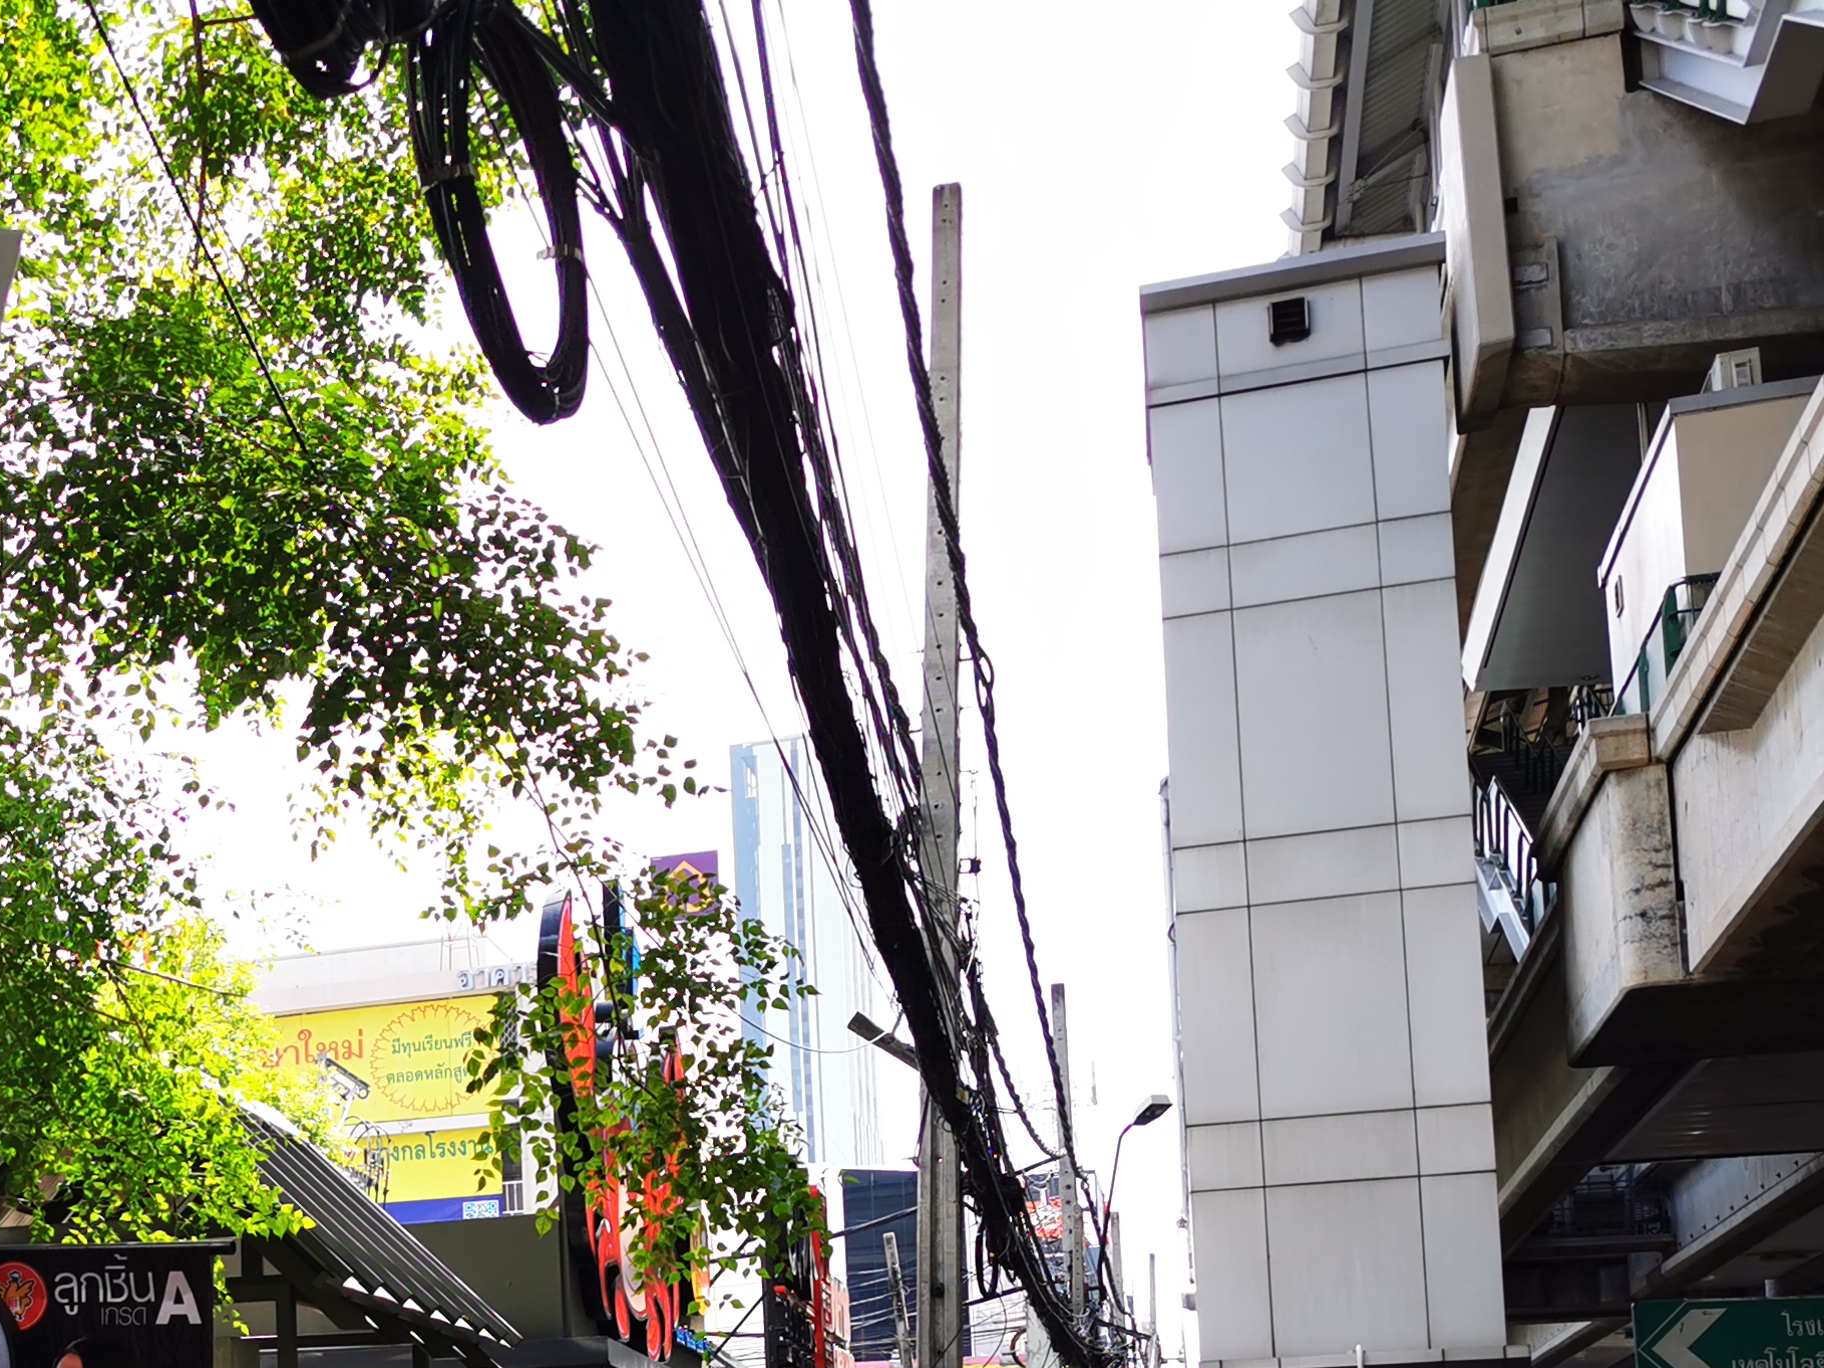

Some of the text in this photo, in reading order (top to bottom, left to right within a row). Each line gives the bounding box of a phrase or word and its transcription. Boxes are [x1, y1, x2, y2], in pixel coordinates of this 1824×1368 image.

[53, 1254, 203, 1325] ลูกชิ้น A
[101, 1305, 146, 1327] เกรด
